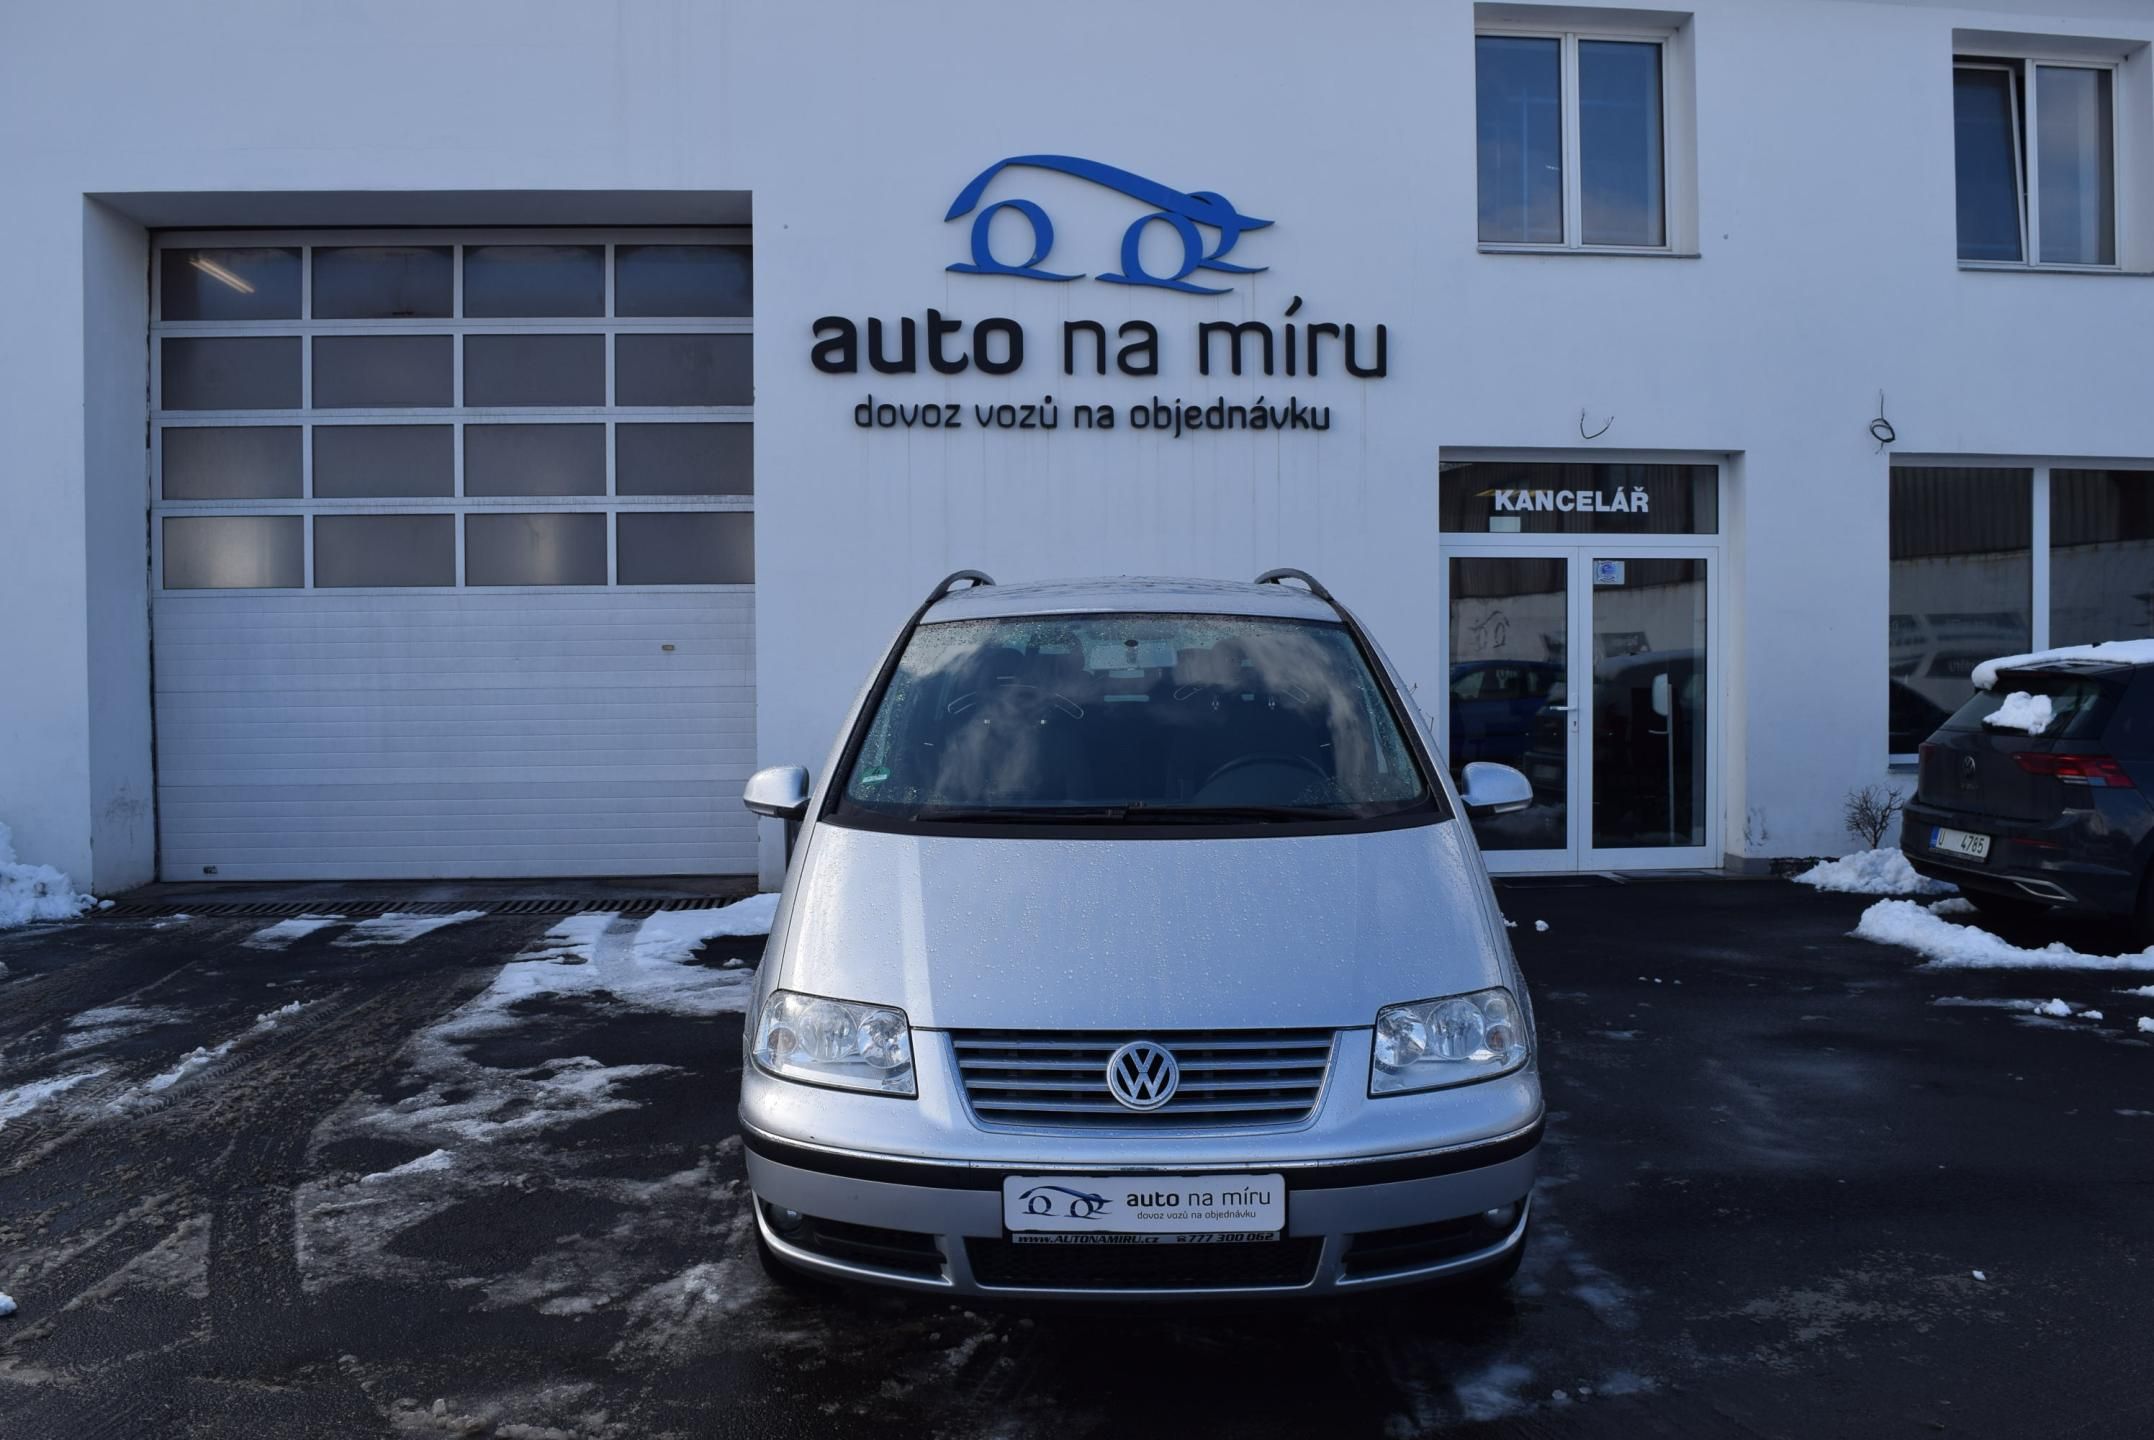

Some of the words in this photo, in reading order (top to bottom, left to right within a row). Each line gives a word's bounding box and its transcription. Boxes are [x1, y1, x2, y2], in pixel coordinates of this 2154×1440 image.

[810, 308, 1024, 375] auto
[1063, 319, 1159, 376] na
[1199, 295, 1388, 378] míru
[854, 395, 961, 429] dovoz
[975, 396, 1058, 429] vozů
[1075, 404, 1115, 430] na
[1130, 397, 1331, 439] objednávku
[1495, 486, 1649, 513] KANCELÁŘ
[1960, 833, 1985, 854] 4785
[1109, 1043, 1178, 1109] VW
[1126, 1191, 1180, 1207] auto
[1188, 1192, 1214, 1206] na
[1222, 1186, 1271, 1206] míru
[1137, 1211, 1164, 1220] dovoz
[1166, 1210, 1188, 1220] vozů
[1205, 1210, 1256, 1221] objednávku
[1189, 1234, 1213, 1243] 777
[1216, 1233, 1244, 1242] 300
